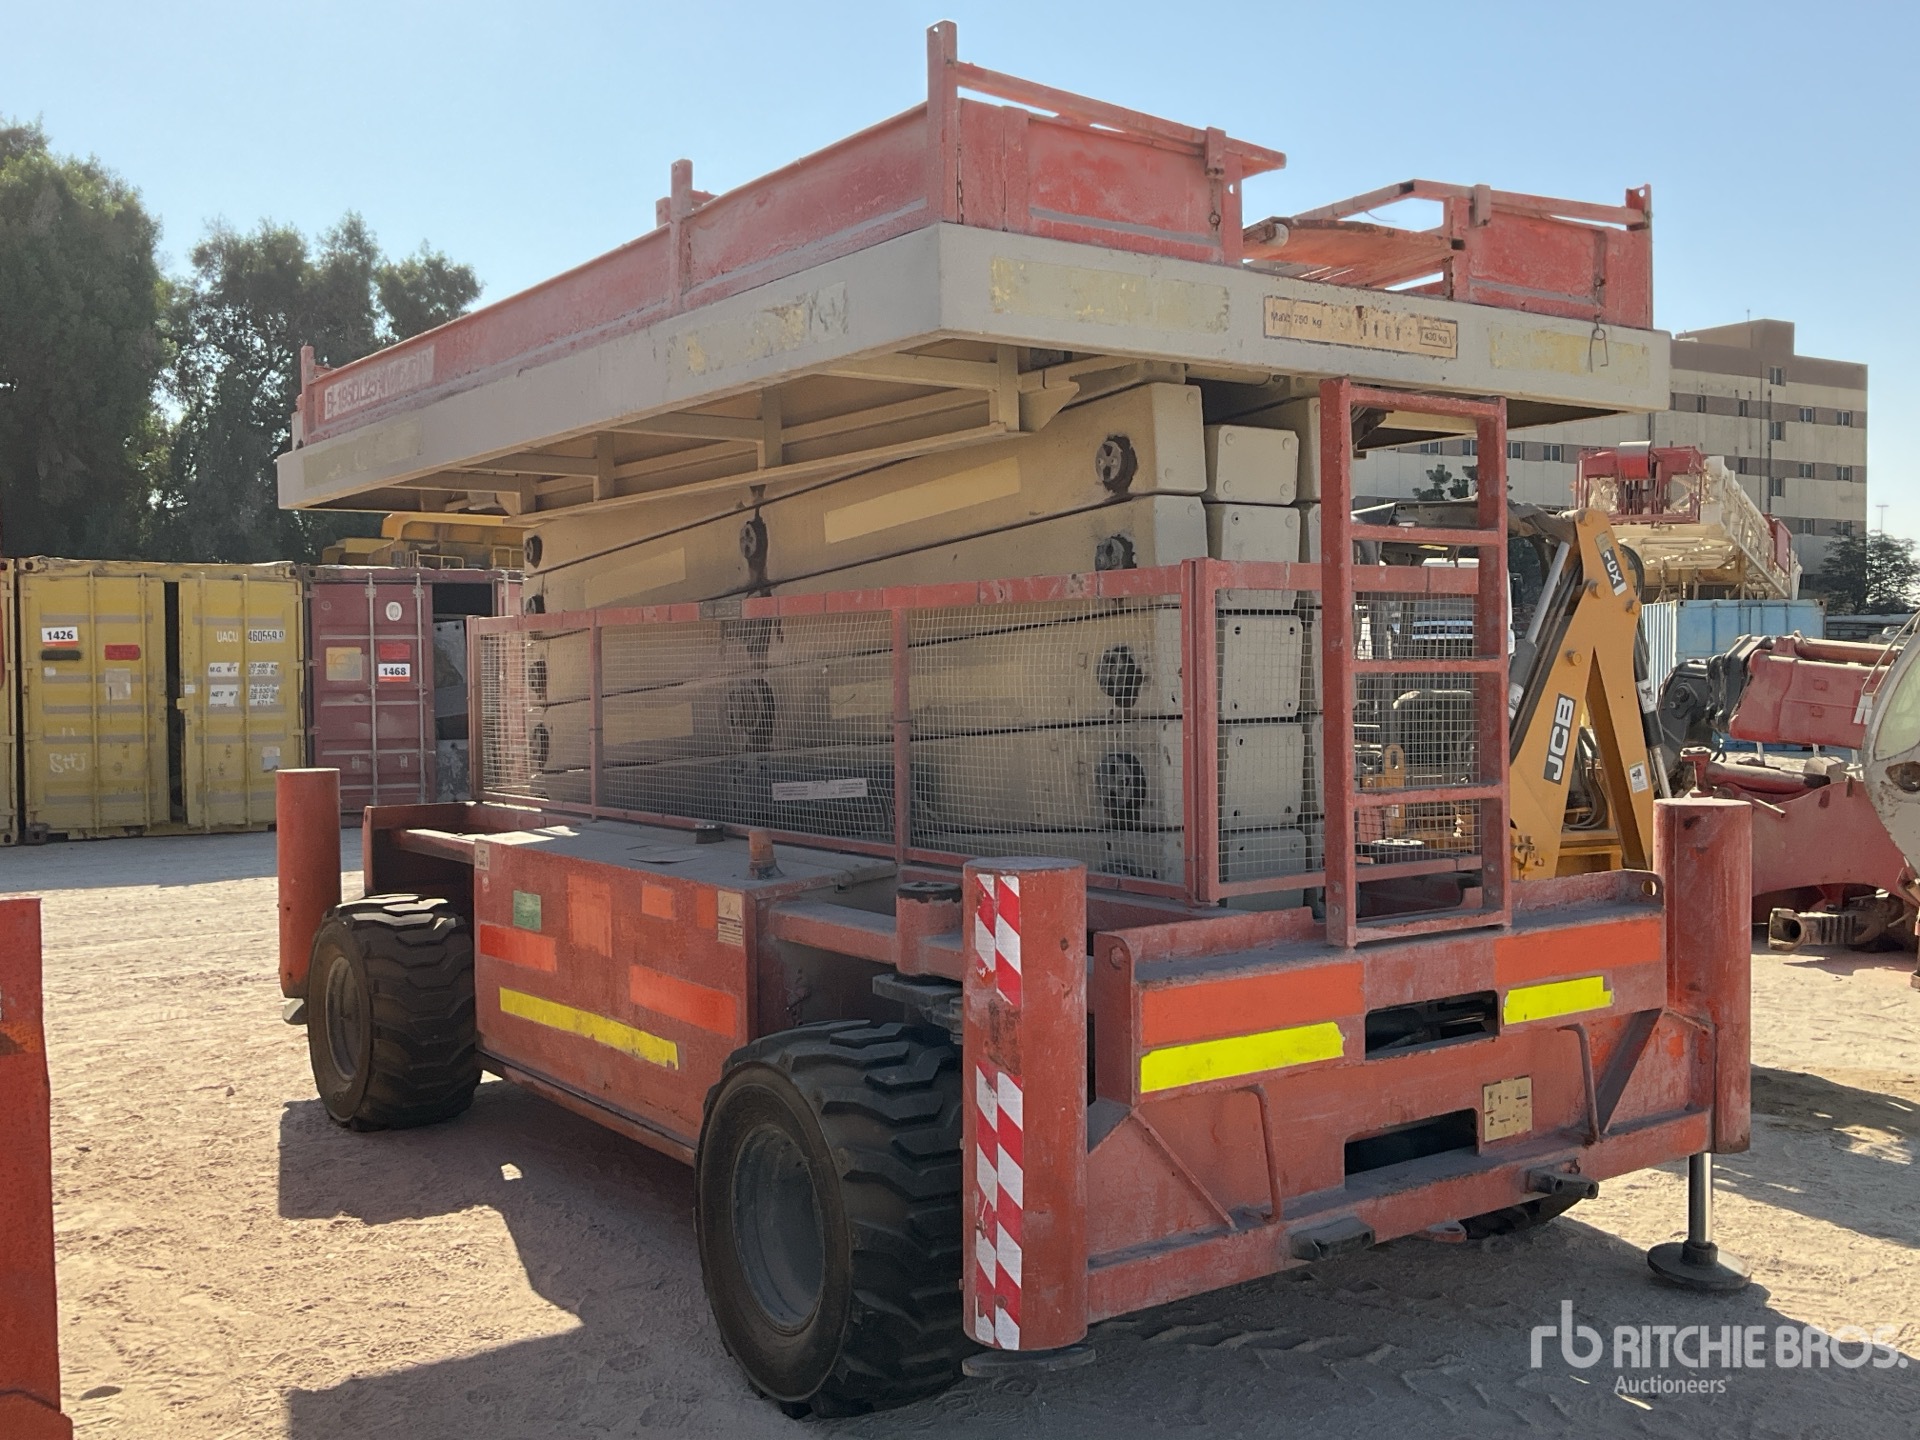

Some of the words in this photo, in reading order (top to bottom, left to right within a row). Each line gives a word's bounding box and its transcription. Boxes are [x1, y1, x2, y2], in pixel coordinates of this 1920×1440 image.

[1294, 314, 1309, 325] 750
[1312, 317, 1322, 329] kg
[46, 630, 74, 641] 1426
[216, 630, 239, 643] UACU
[383, 667, 407, 676] 1468
[1548, 697, 1574, 781] JCB
